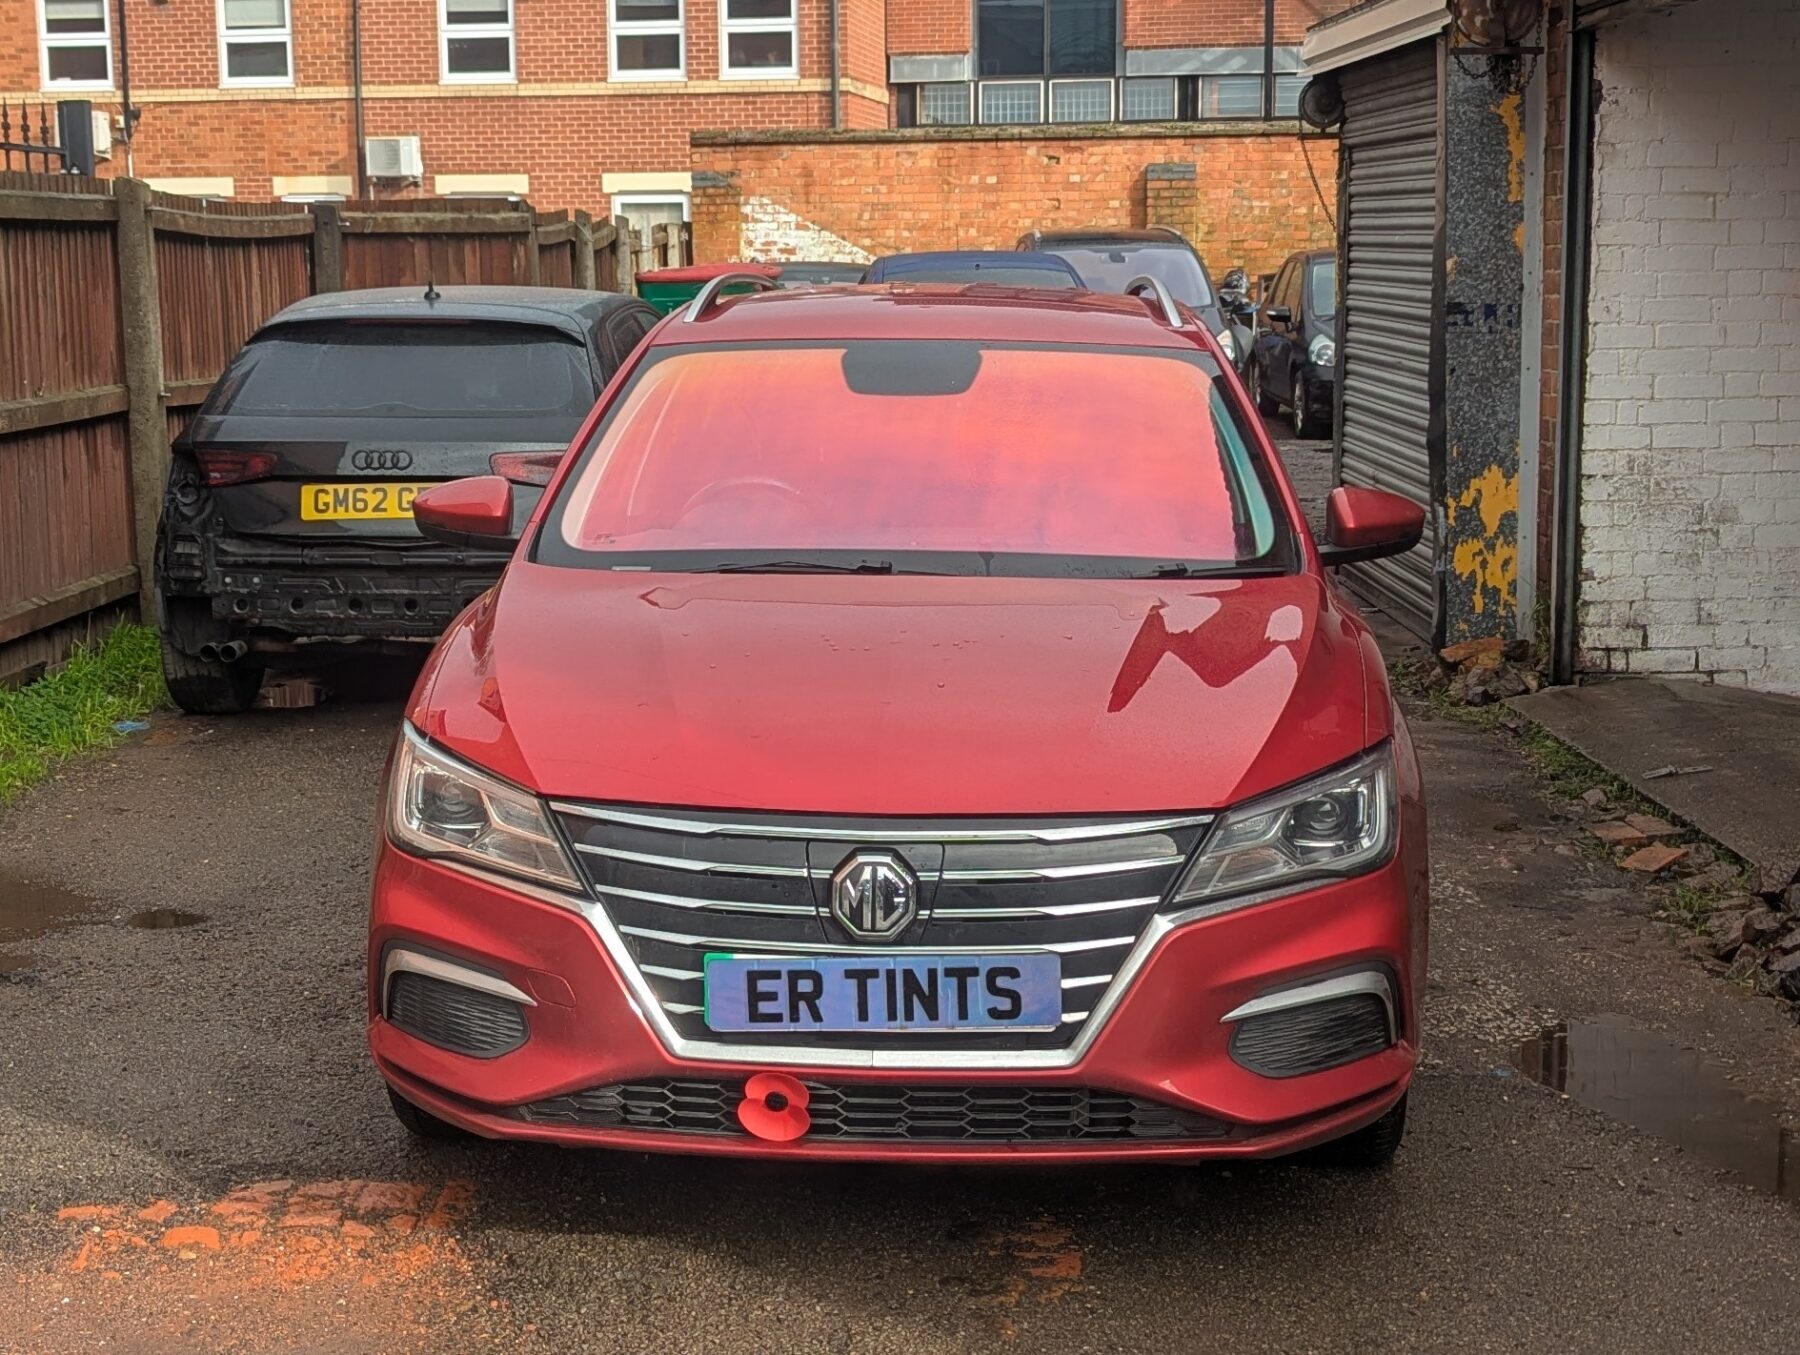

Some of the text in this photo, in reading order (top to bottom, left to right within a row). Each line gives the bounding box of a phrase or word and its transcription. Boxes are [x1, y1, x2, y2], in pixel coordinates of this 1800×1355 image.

[314, 487, 388, 514] GM62
[841, 865, 906, 931] MG
[746, 966, 1022, 1023] ER TINTS
